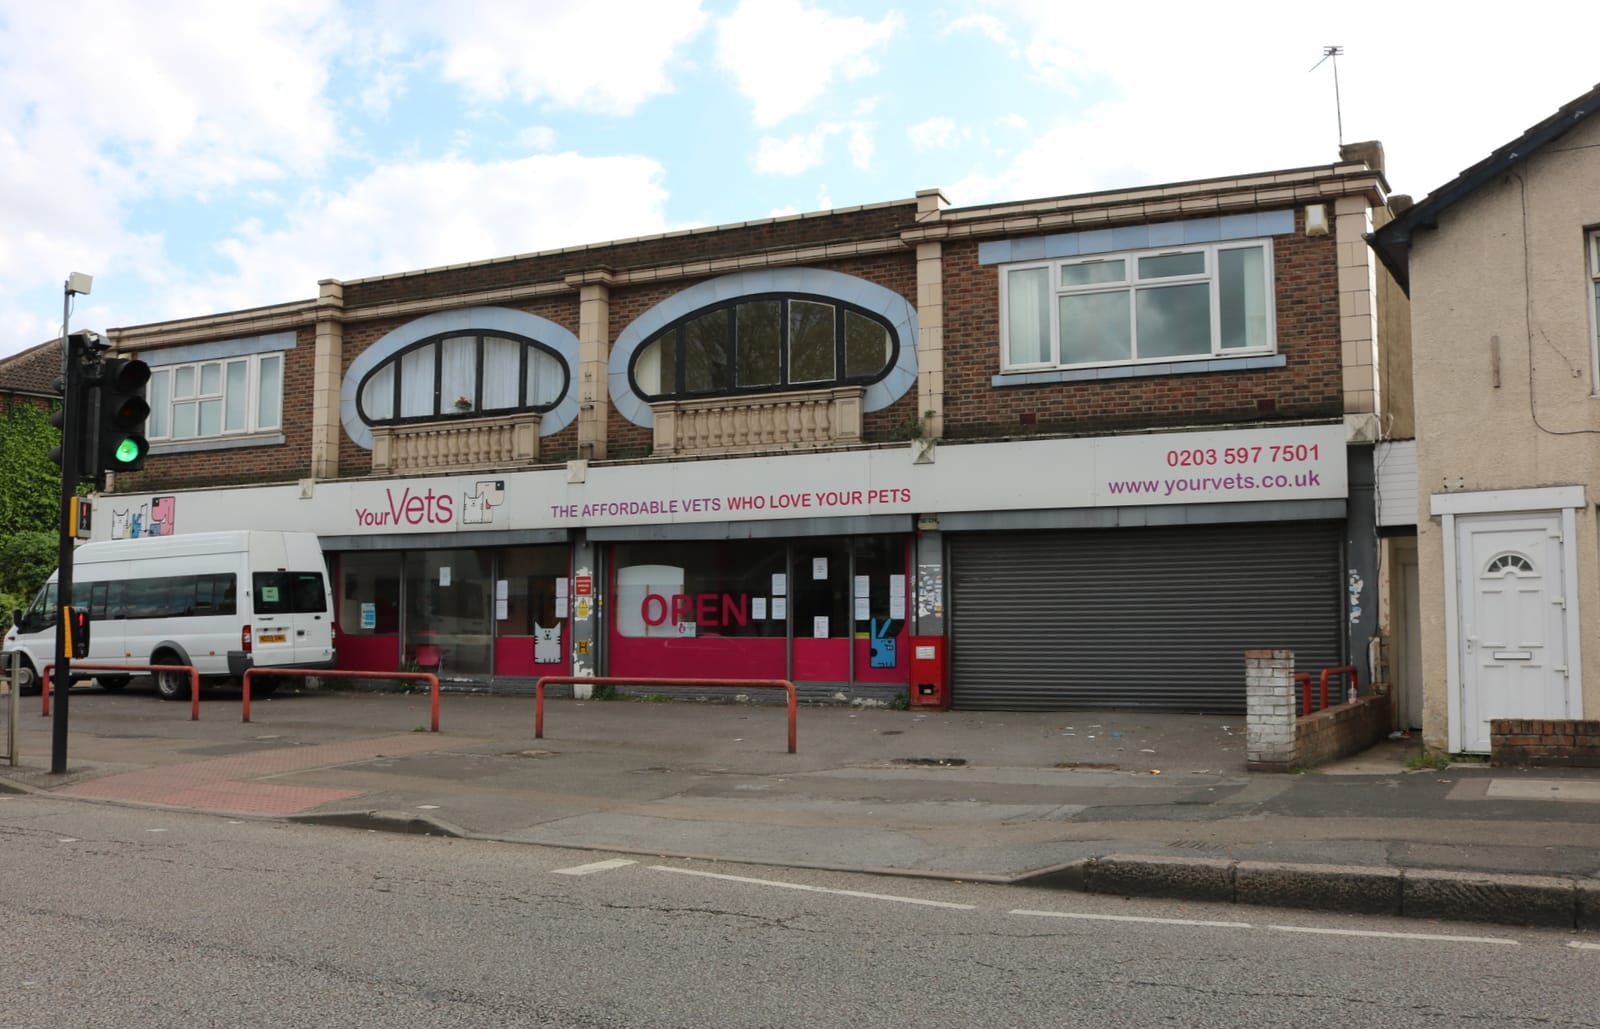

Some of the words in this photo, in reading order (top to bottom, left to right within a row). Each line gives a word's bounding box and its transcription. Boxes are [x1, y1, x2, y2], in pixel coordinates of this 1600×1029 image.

[1167, 449, 1217, 467] 0203
[1223, 447, 1262, 465] 597
[1269, 444, 1319, 462] 7501
[551, 505, 578, 518] THE
[581, 500, 678, 517] AFFORDABLE
[682, 498, 721, 513] VETS
[727, 496, 766, 510] WHO
[769, 493, 812, 509] LOVE
[815, 490, 863, 507] YOUR
[867, 488, 912, 504] PETS
[641, 593, 748, 627] OPEN
[579, 641, 588, 653] H
